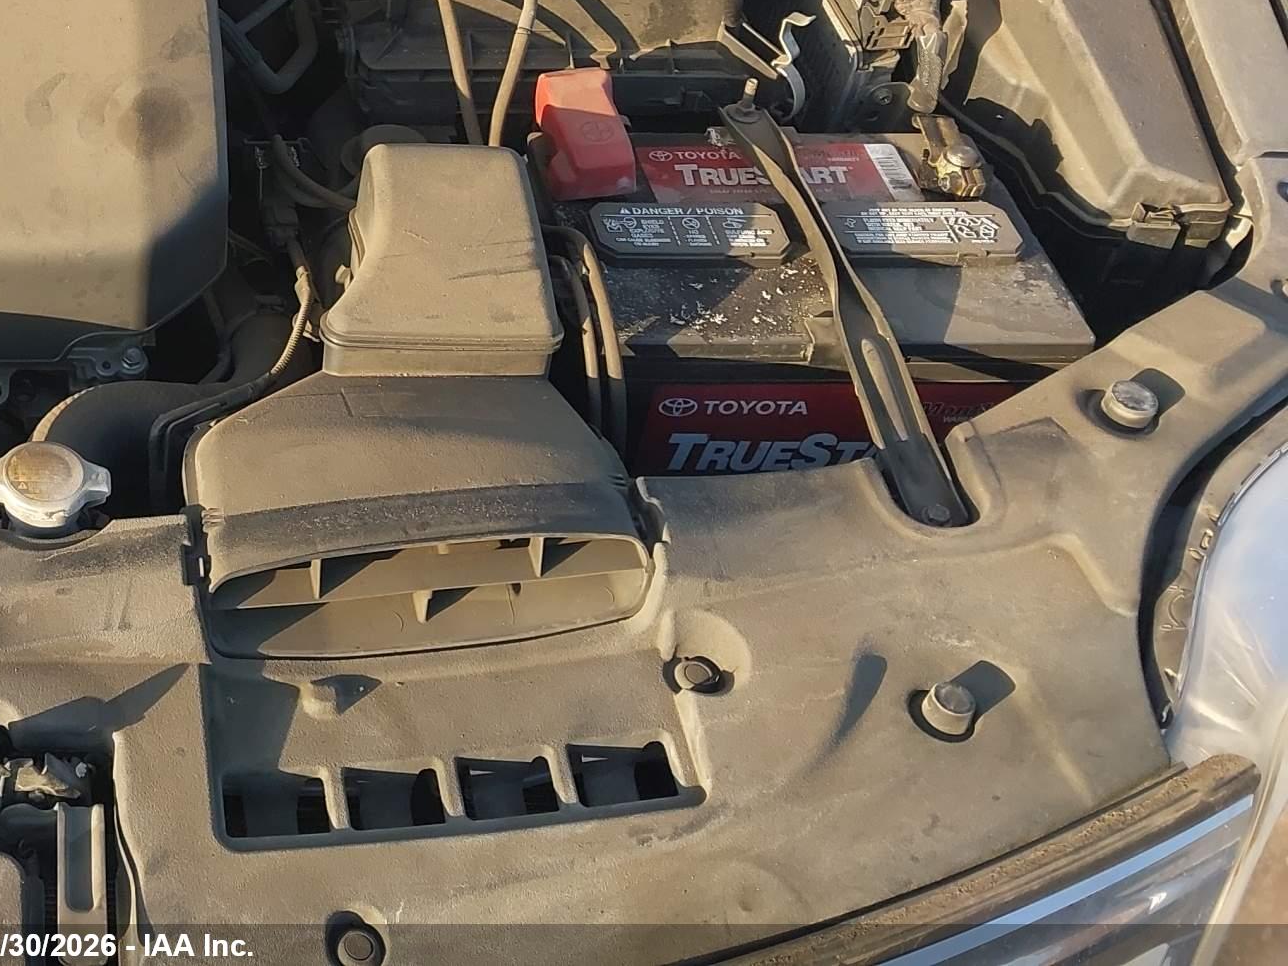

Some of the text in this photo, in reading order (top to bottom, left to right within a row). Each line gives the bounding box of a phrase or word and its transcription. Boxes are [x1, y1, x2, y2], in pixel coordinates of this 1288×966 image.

[675, 150, 743, 161] TOYOTA
[696, 207, 744, 215] POISON
[704, 400, 809, 416] TOYOTA
[668, 433, 877, 472] TRUEST
